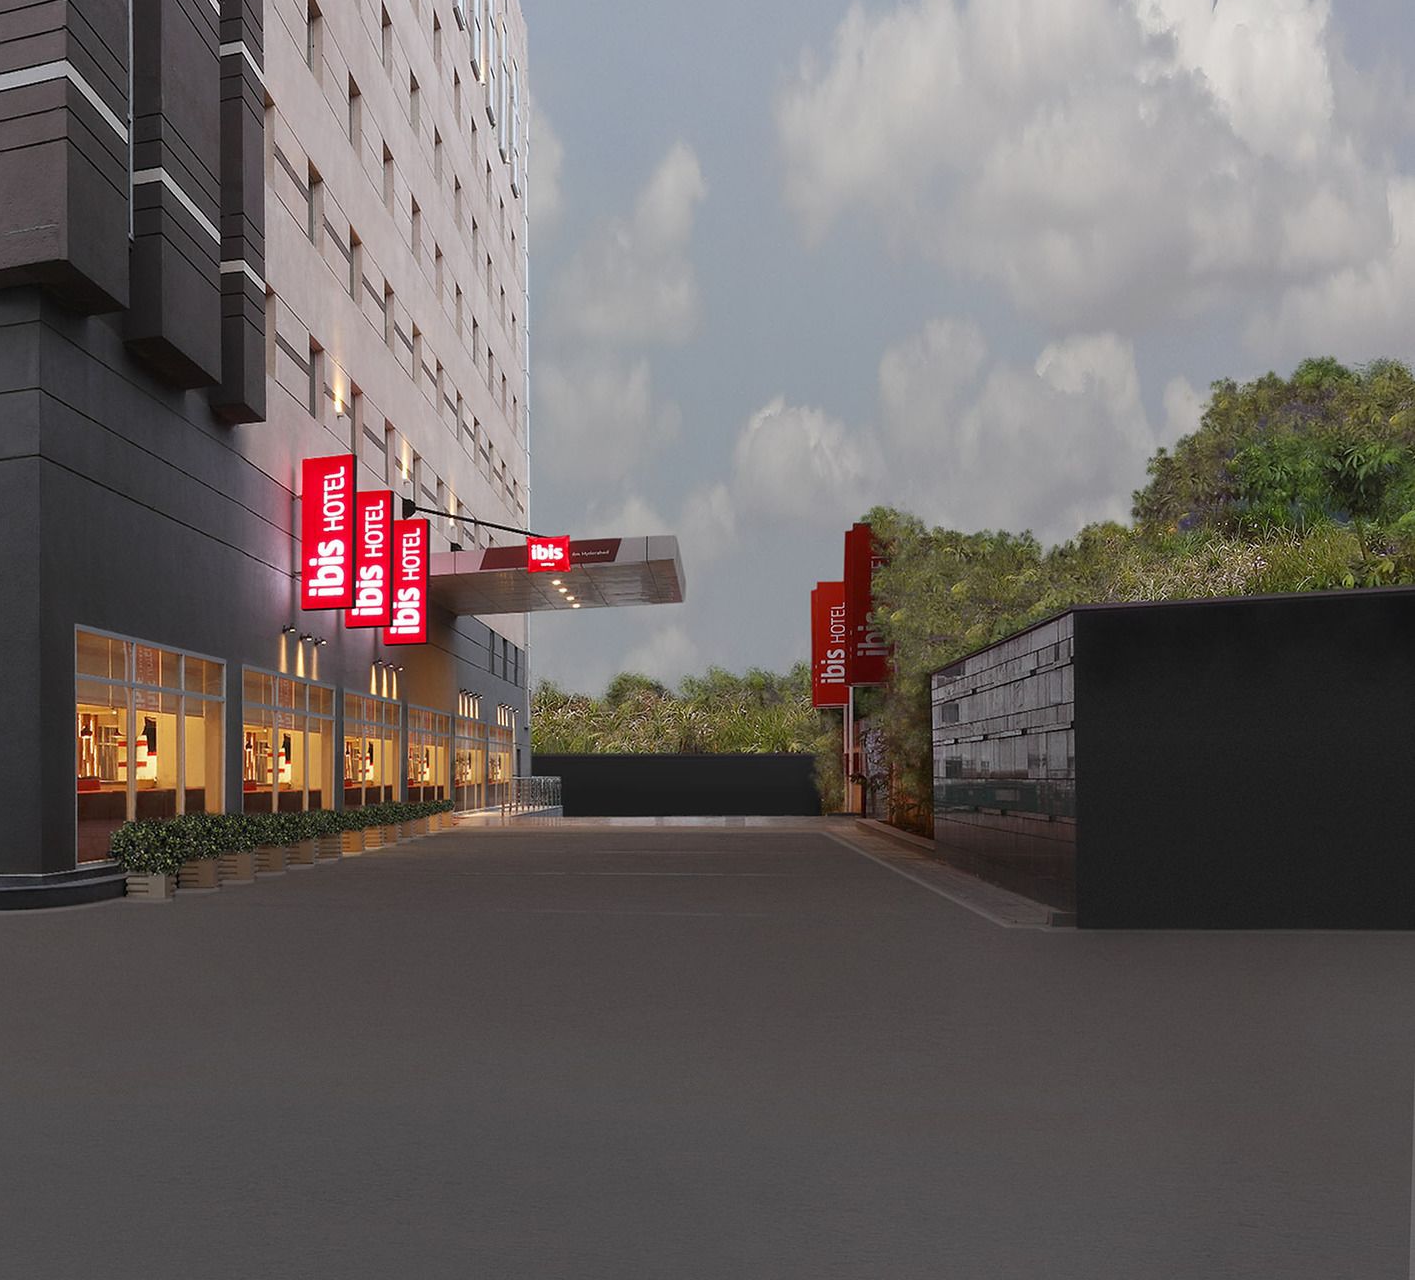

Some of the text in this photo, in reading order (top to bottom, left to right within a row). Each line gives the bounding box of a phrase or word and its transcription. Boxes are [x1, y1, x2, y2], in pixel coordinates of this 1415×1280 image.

[309, 466, 345, 597] ibis HOTEL
[352, 500, 384, 616] ibis HOTEL
[390, 528, 420, 635] ibis HOTEL
[531, 544, 563, 560] ibis
[821, 602, 846, 684] ibis HOTEL
